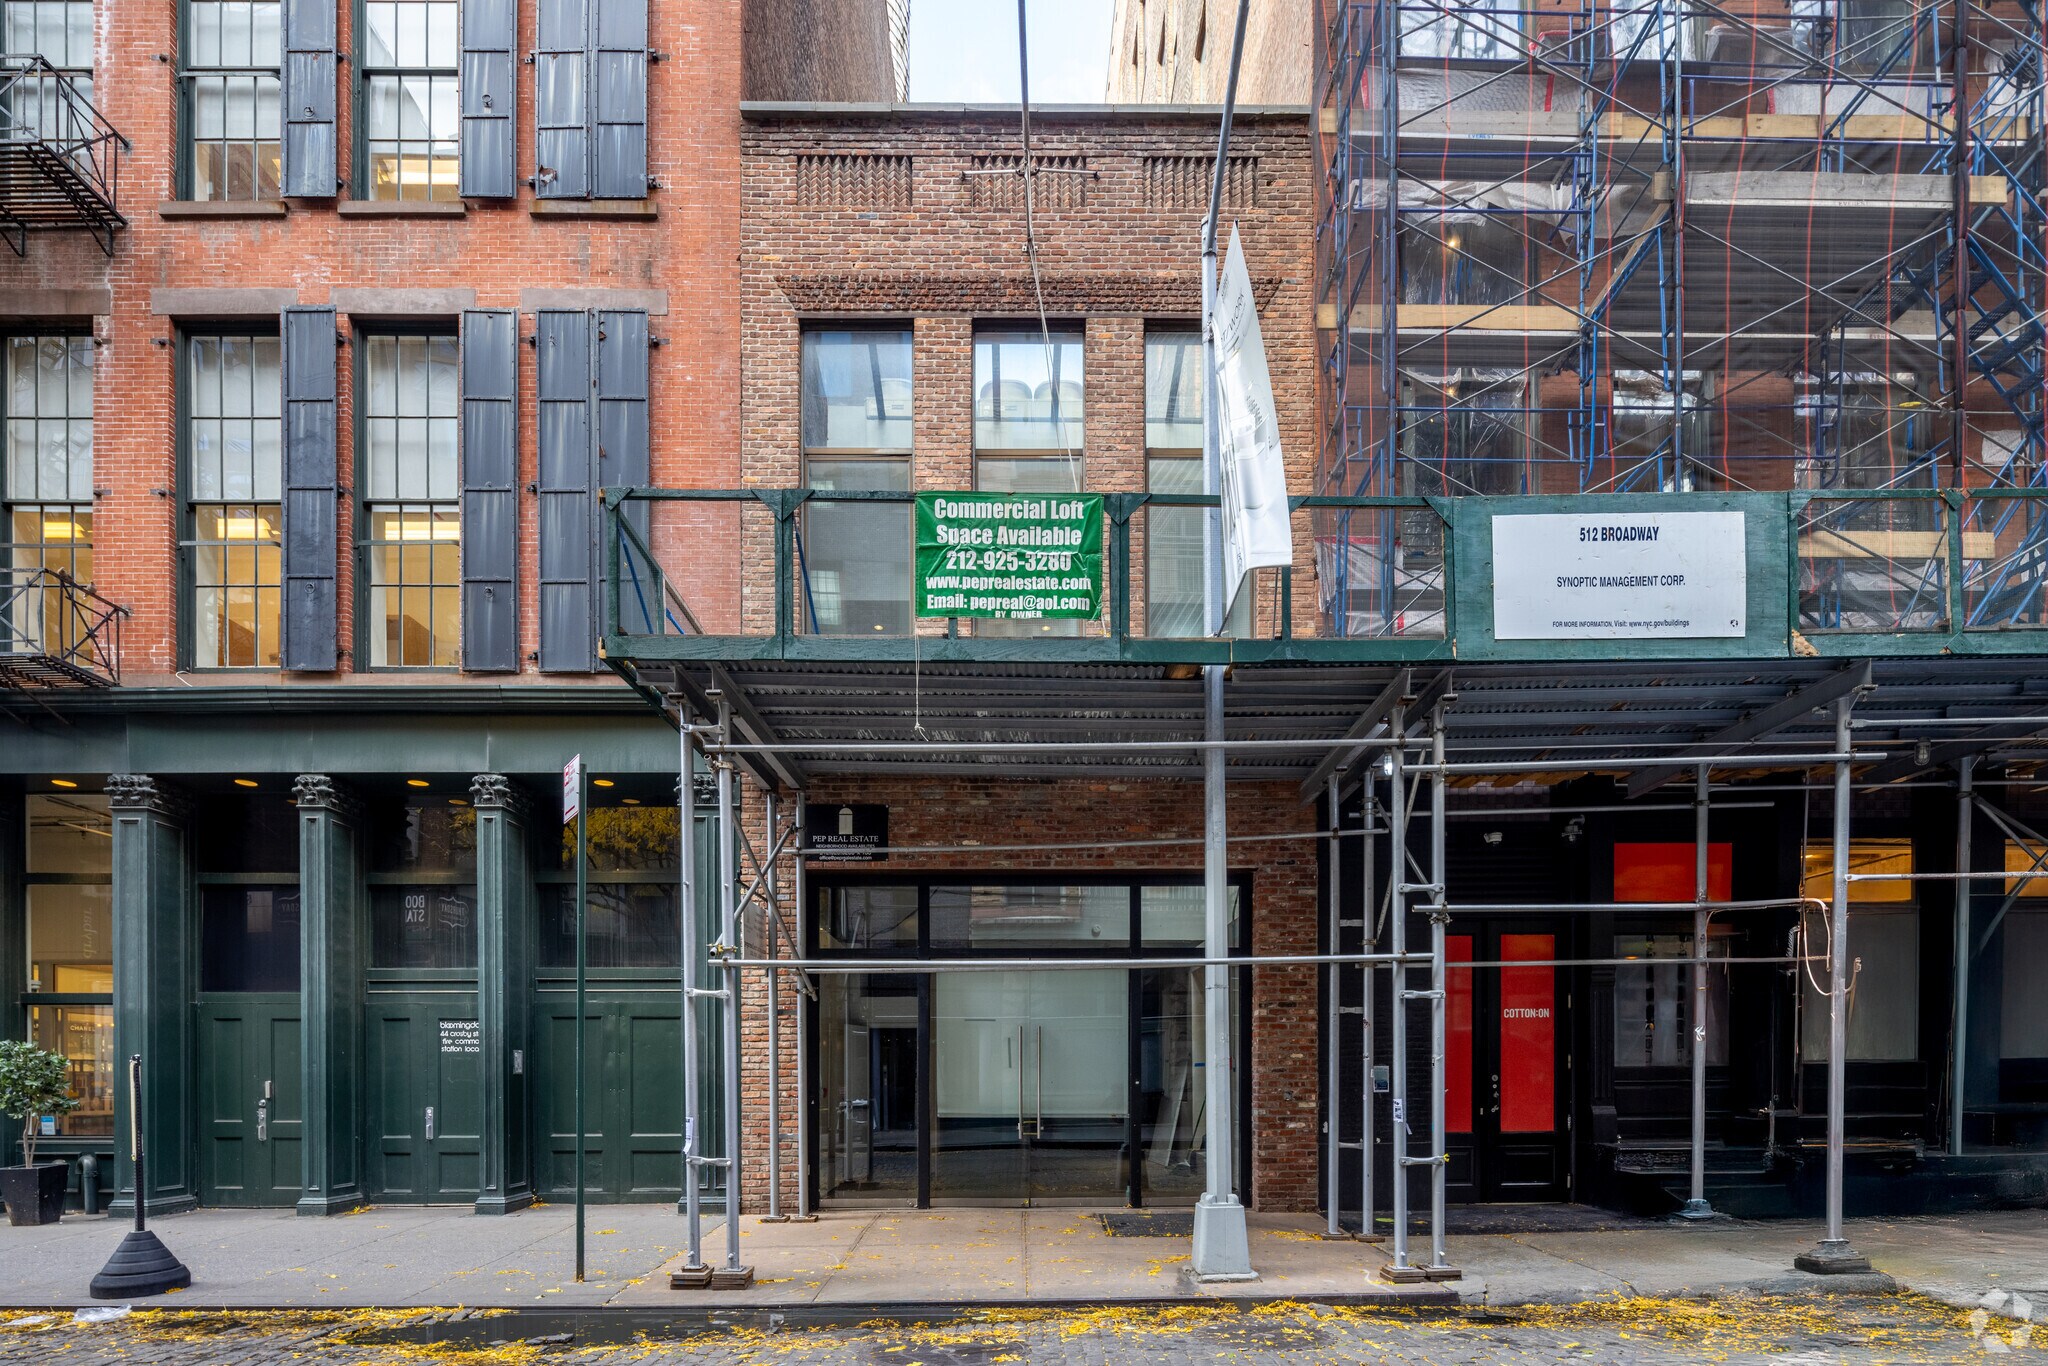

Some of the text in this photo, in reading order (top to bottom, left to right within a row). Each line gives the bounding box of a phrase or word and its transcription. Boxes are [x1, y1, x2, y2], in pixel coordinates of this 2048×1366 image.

[934, 499, 1084, 520] Commercial Loft
[936, 524, 1082, 546] Space Available
[1580, 526, 1659, 541] 512 BROADWAY
[946, 551, 1071, 571] 212-925-3280
[925, 576, 1091, 591] www.peprealestate.com
[1556, 575, 1686, 587] SYNOPTIC MANAGEMENT CORP.
[927, 594, 1090, 611] Email: pepreal@aol.com
[1629, 620, 1690, 629] www.nyc.gov/buildings
[1503, 1008, 1550, 1018] COTTON:ON
